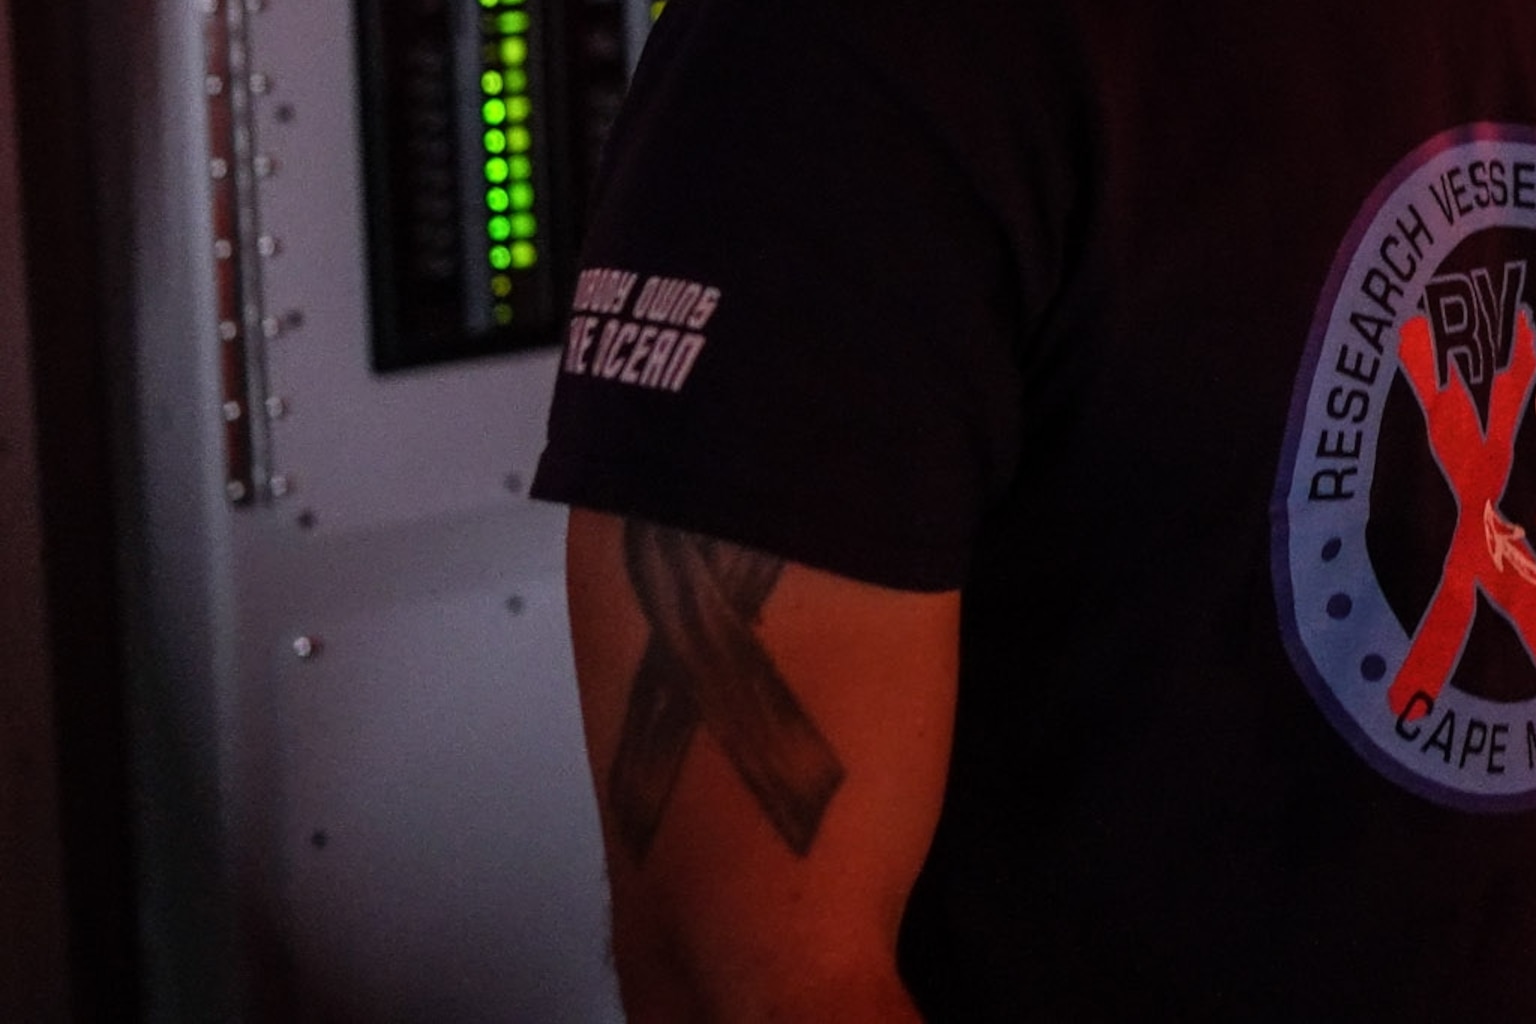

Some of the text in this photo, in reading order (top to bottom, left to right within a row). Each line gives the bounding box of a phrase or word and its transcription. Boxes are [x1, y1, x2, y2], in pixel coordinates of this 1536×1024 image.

[1308, 204, 1435, 503] RESEARCH
[1423, 259, 1528, 394] RV
[1395, 690, 1510, 774] CAPE
